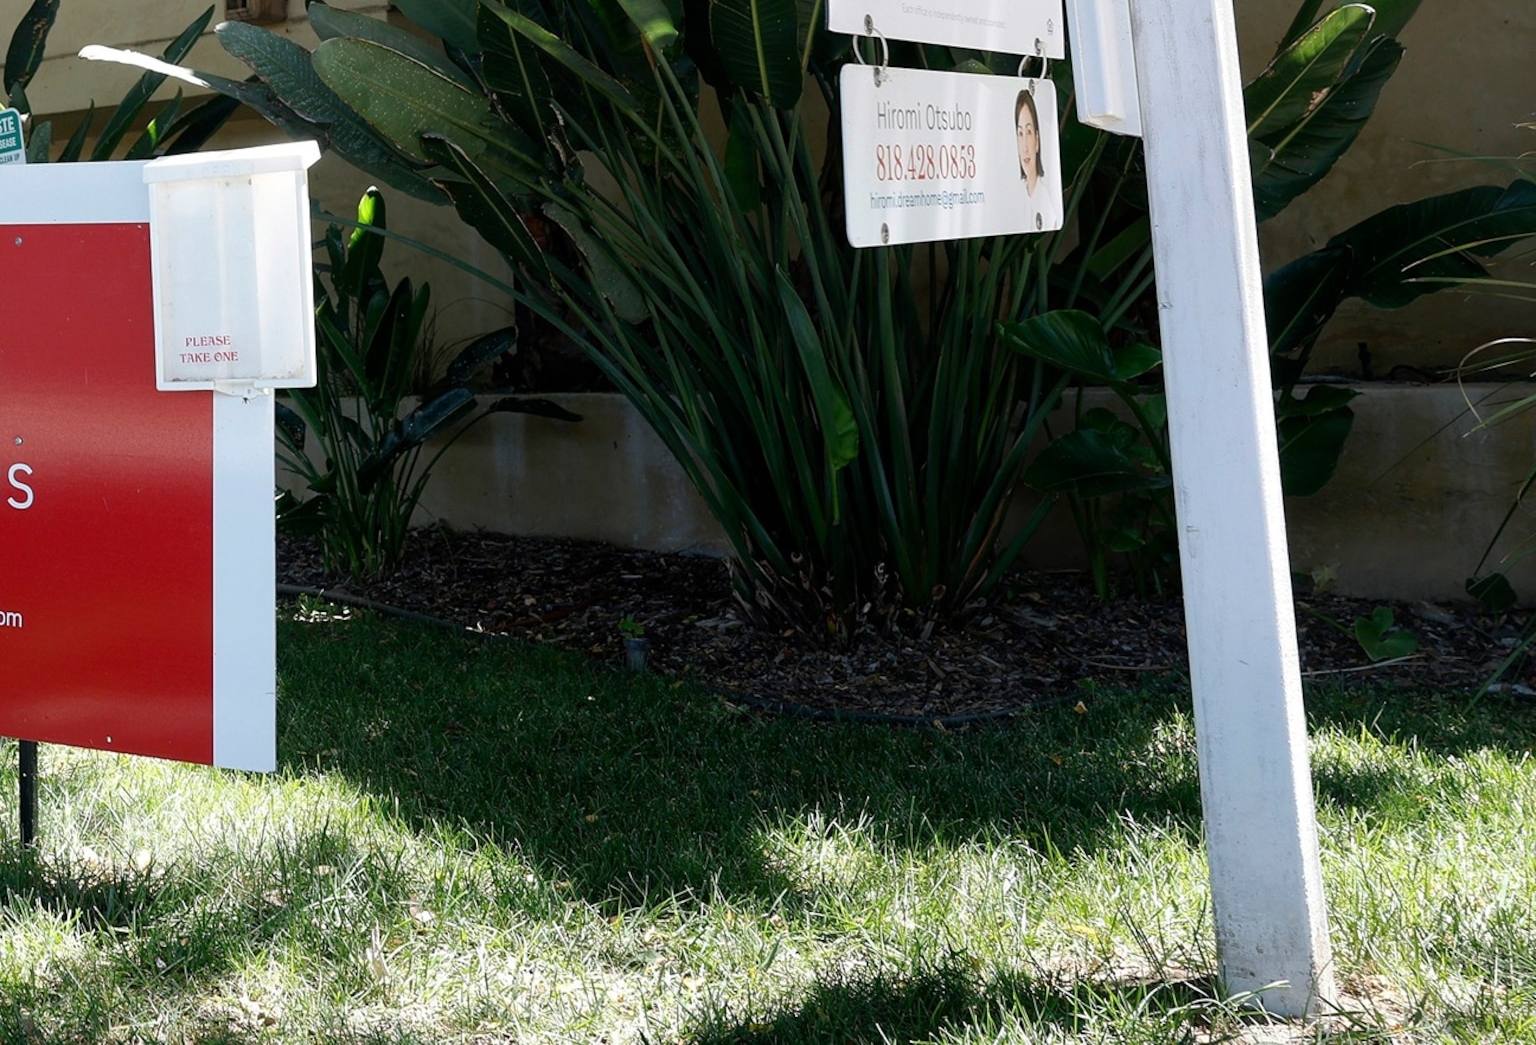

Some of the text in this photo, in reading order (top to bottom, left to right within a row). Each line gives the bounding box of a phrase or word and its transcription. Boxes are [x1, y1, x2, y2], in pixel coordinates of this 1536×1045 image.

[876, 100, 972, 131] Hiromi Otsubo
[876, 144, 977, 181] 818.428.0853
[185, 335, 232, 347] PLEASE
[179, 351, 239, 363] TAKE ONE
